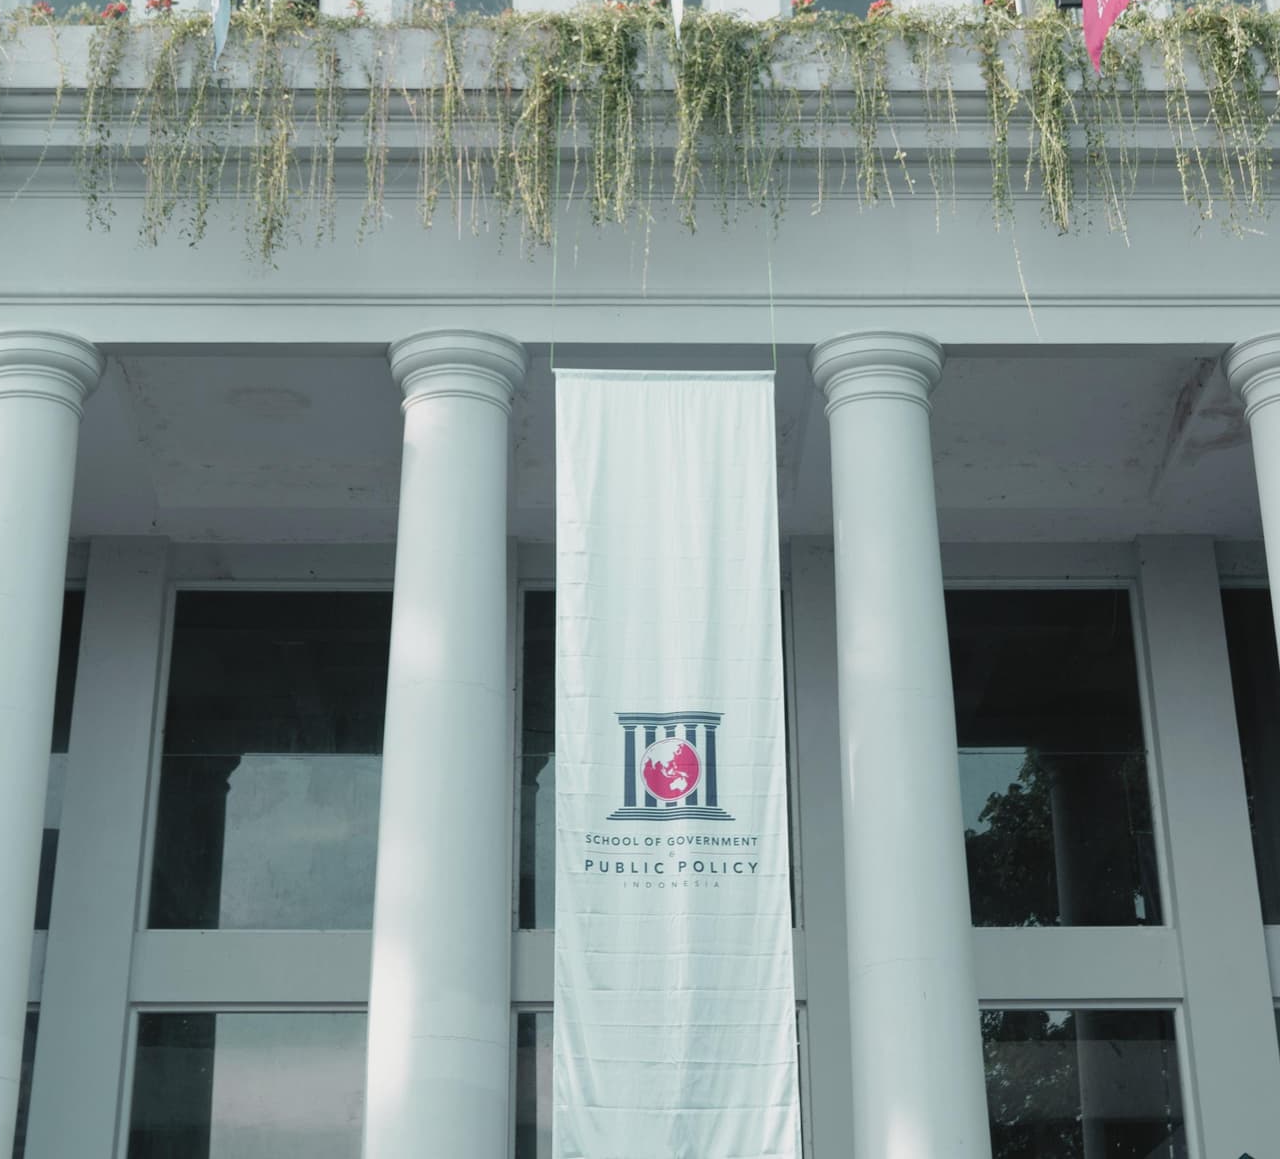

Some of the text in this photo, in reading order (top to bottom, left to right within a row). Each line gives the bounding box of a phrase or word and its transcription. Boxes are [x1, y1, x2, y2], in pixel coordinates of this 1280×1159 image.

[585, 834, 758, 847] SCHOOL OF GOVERNMENT
[585, 859, 759, 874] PUBLIC POLICY
[623, 880, 720, 889] INDONESIA
